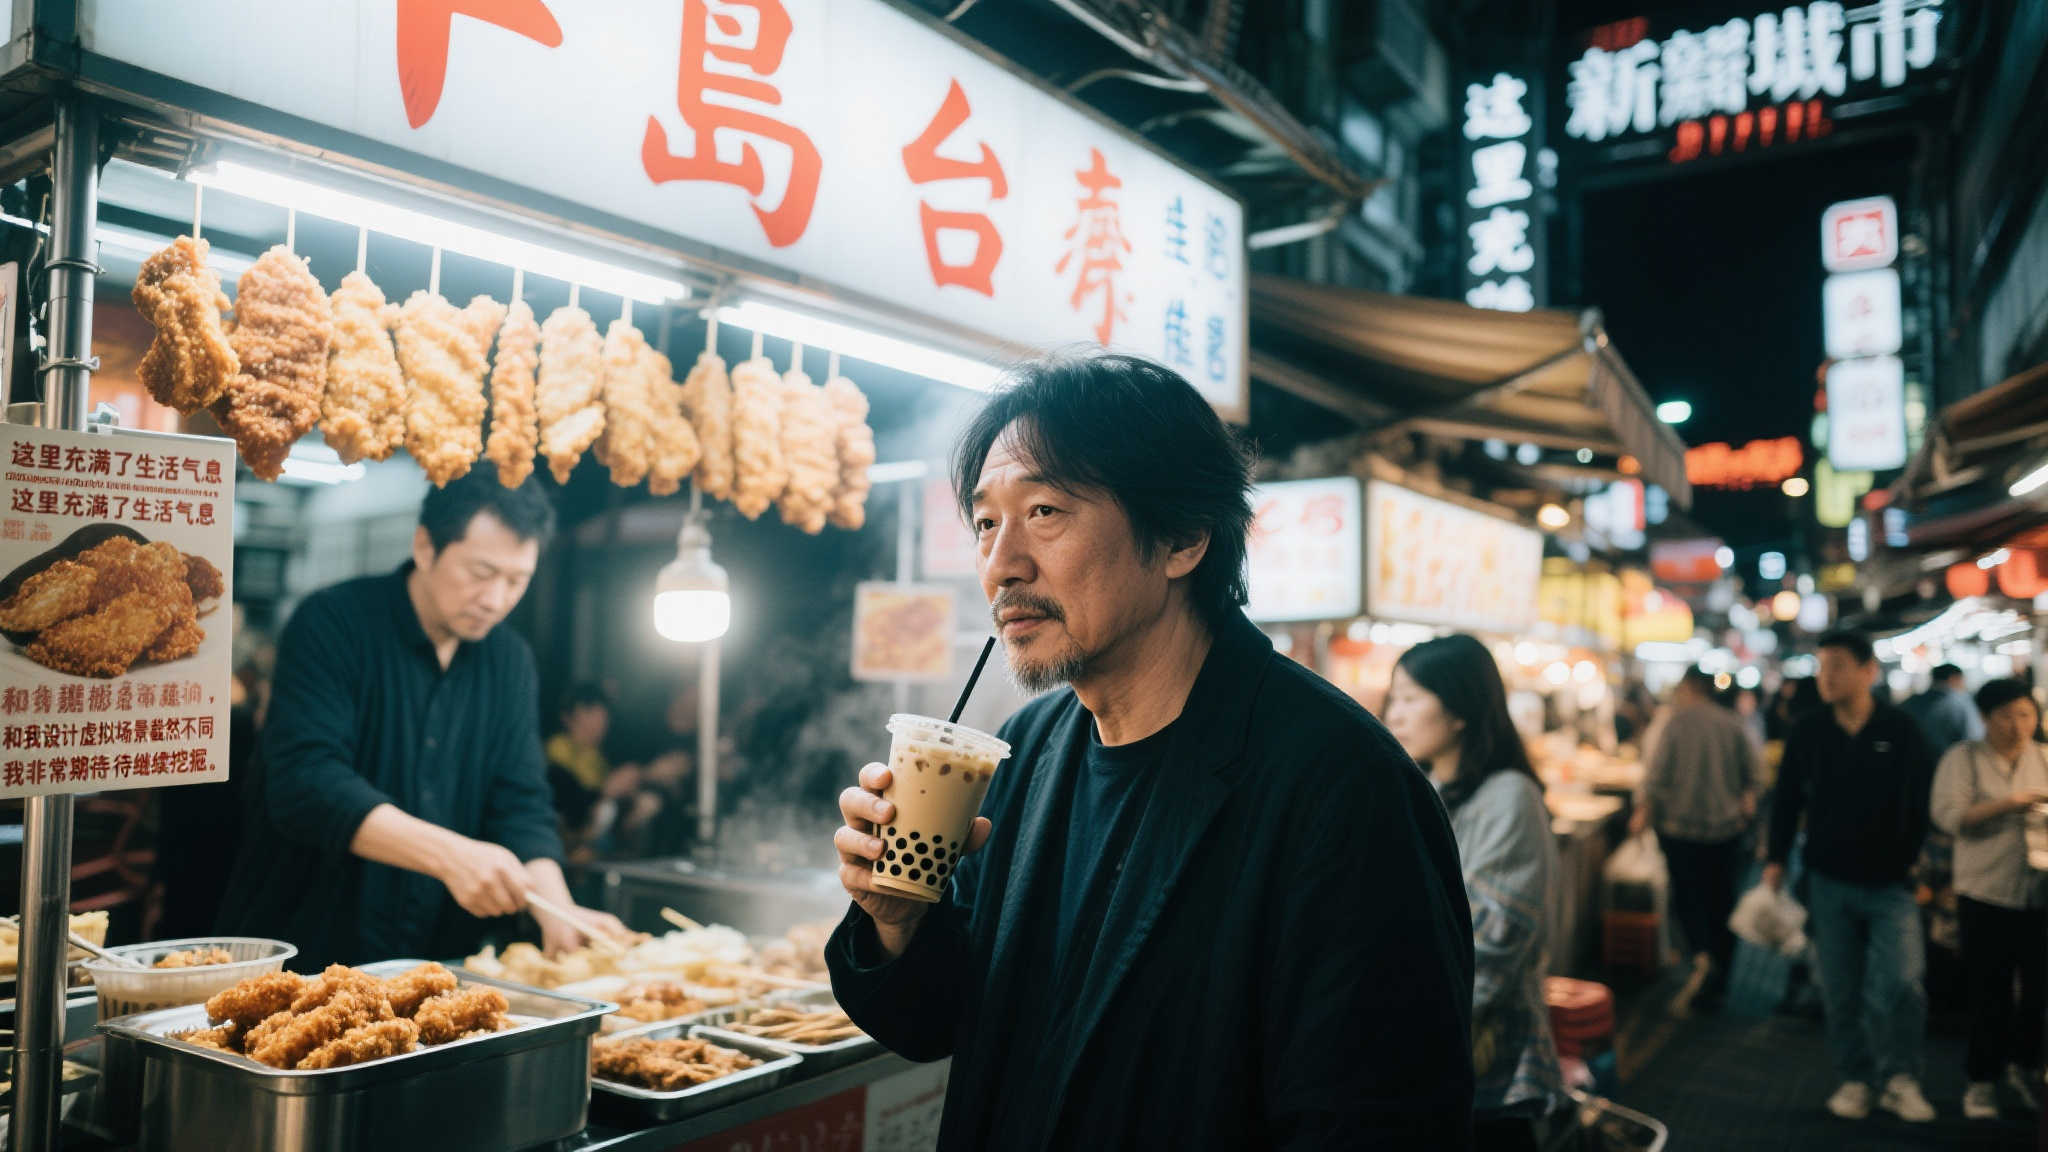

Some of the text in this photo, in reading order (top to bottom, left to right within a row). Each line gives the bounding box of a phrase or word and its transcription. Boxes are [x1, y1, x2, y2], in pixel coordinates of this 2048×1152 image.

[11, 441, 222, 484] 这里充满了生活气息
[11, 488, 215, 526] 这里充满了生活气息
